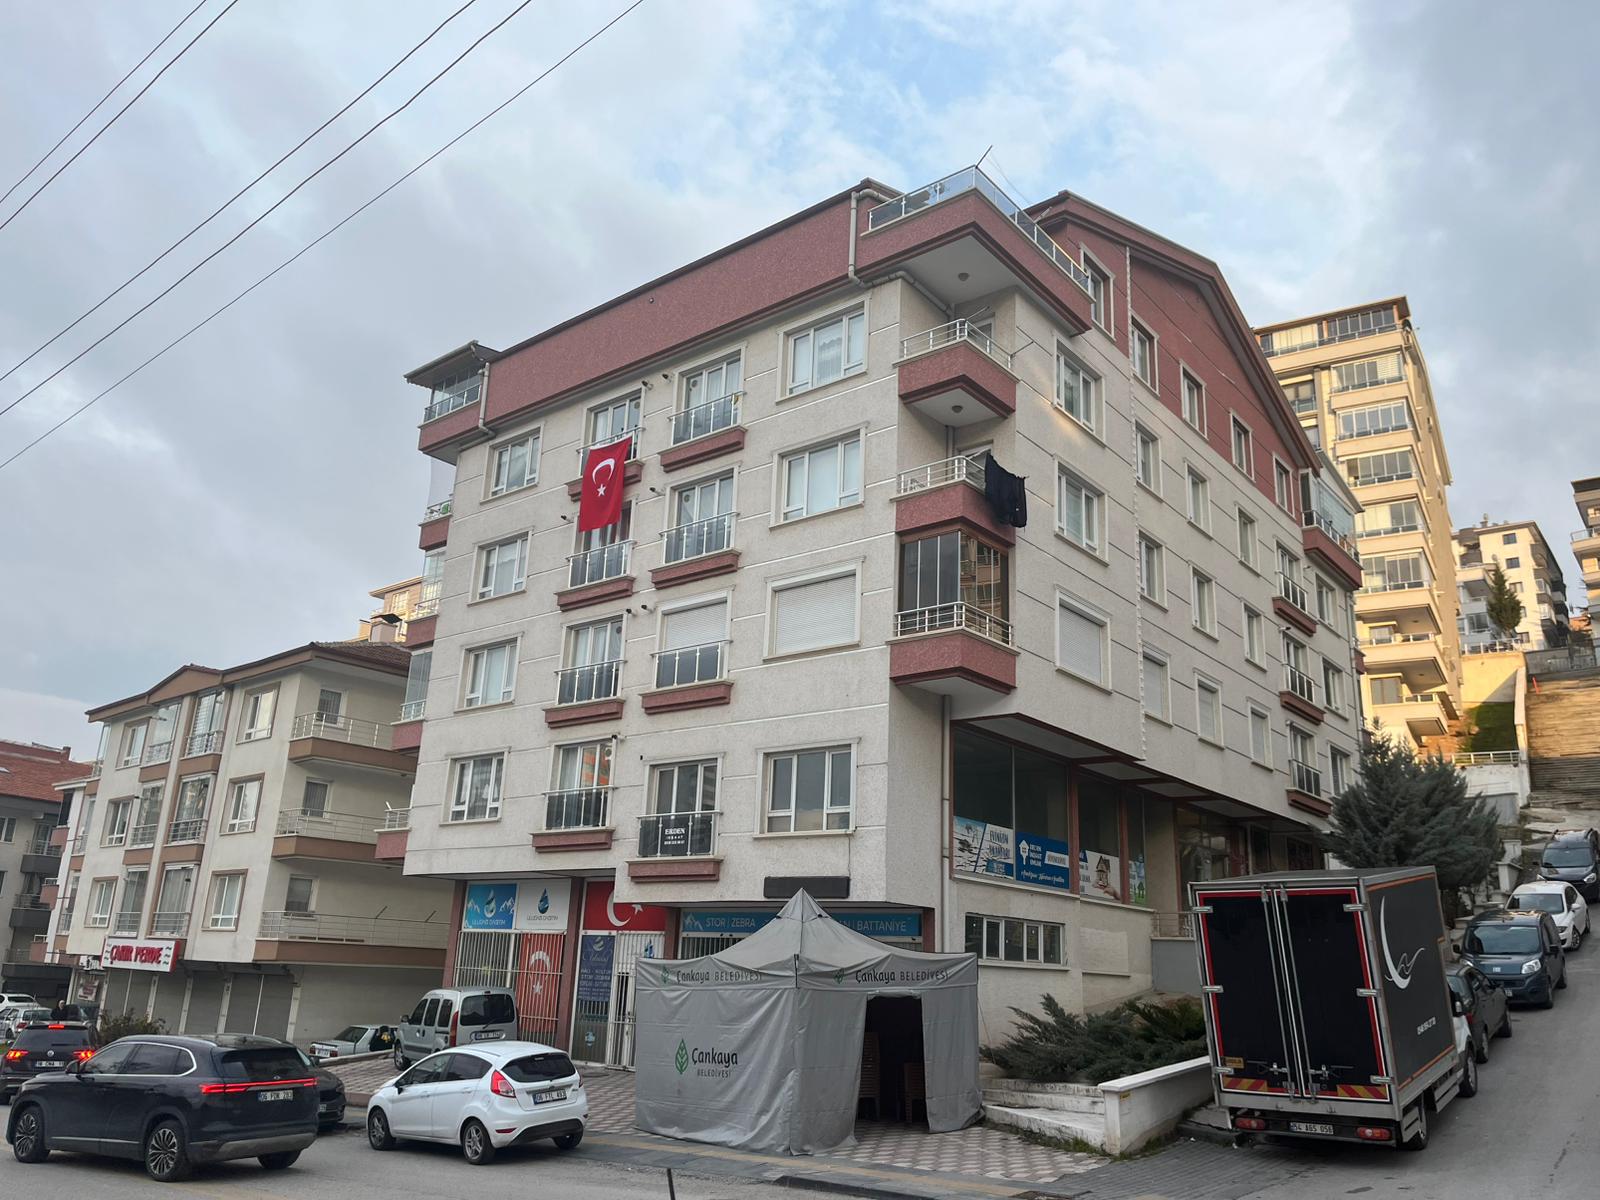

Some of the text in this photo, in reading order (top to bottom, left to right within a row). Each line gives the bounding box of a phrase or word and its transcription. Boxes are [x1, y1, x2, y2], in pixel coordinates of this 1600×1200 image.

[705, 917, 756, 928] STOR ZEBRA
[857, 918, 907, 932] BATTANİYE
[676, 969, 762, 984] Çankaya BELEDİYESİ
[855, 968, 949, 985] Çankaya BELEDİYESİ
[691, 1047, 738, 1068] Çankaya
[697, 1068, 731, 1079] BELEDİYESİ
